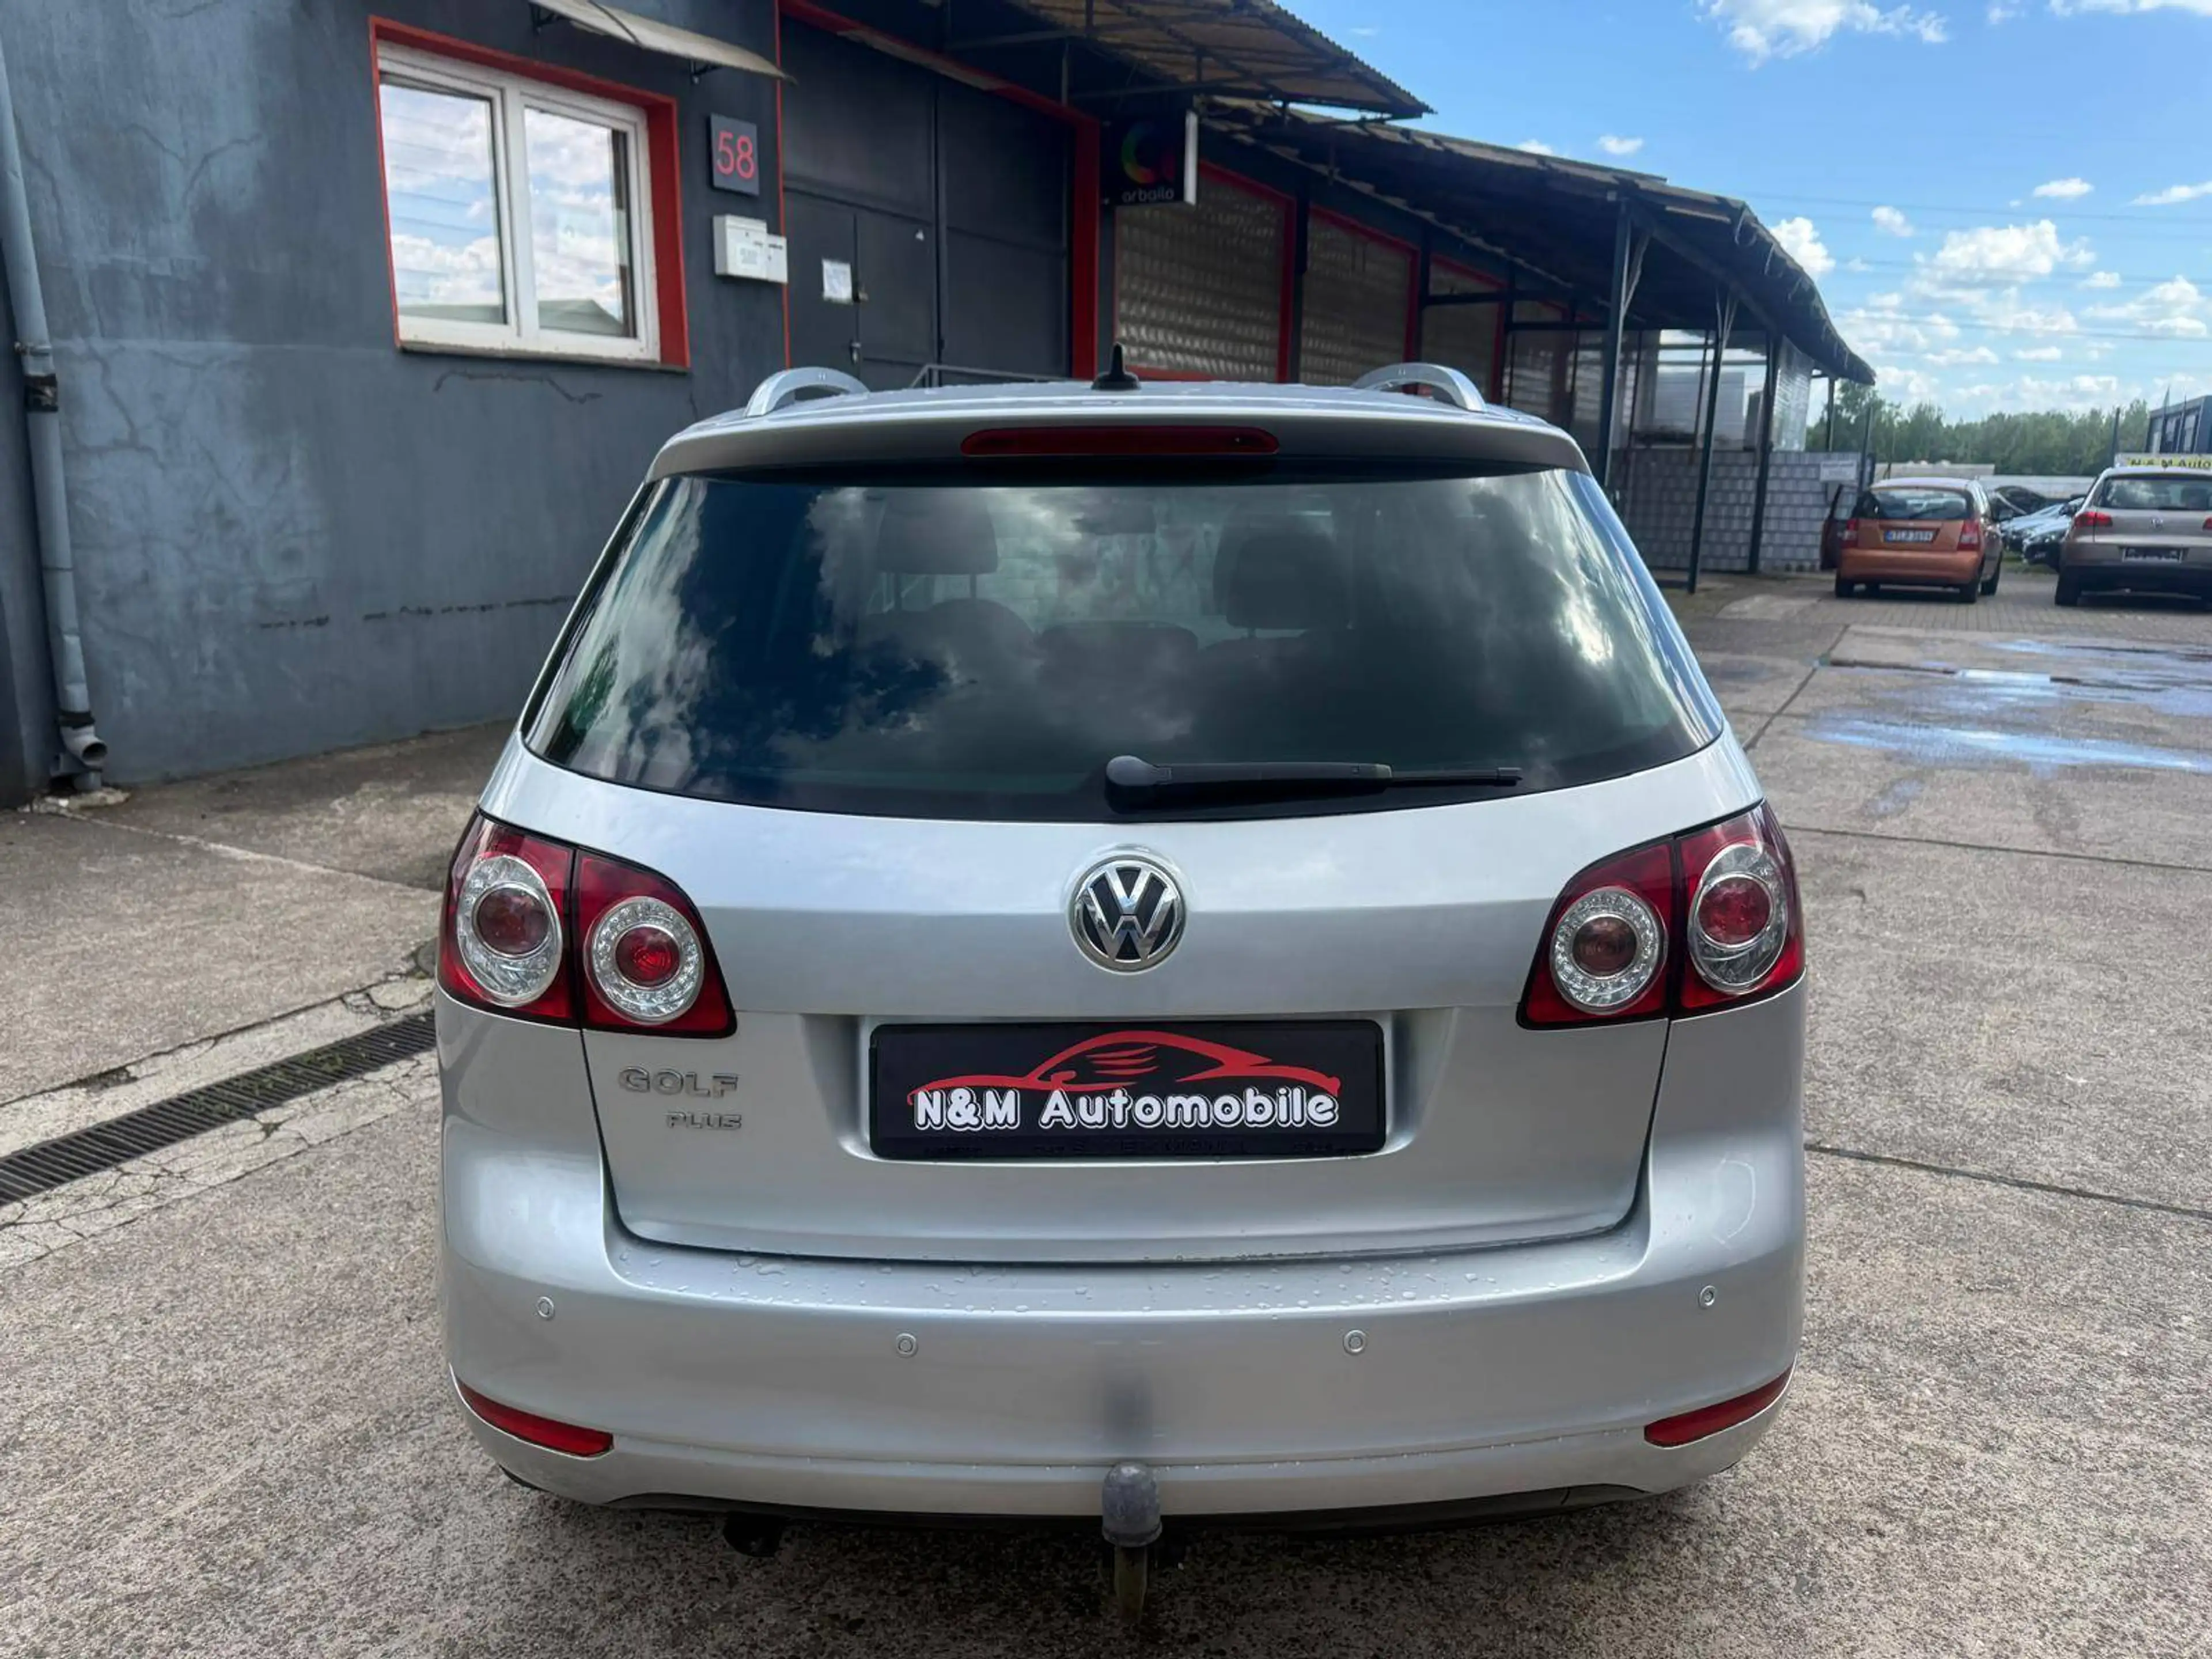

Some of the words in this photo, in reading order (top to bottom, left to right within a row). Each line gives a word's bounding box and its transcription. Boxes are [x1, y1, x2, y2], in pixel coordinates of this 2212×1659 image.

[717, 130, 754, 178] 58
[618, 1065, 739, 1099] GOLF
[666, 1111, 742, 1130] PLUS
[915, 1086, 1020, 1131] N&M
[1038, 1085, 1339, 1129] Automobile
